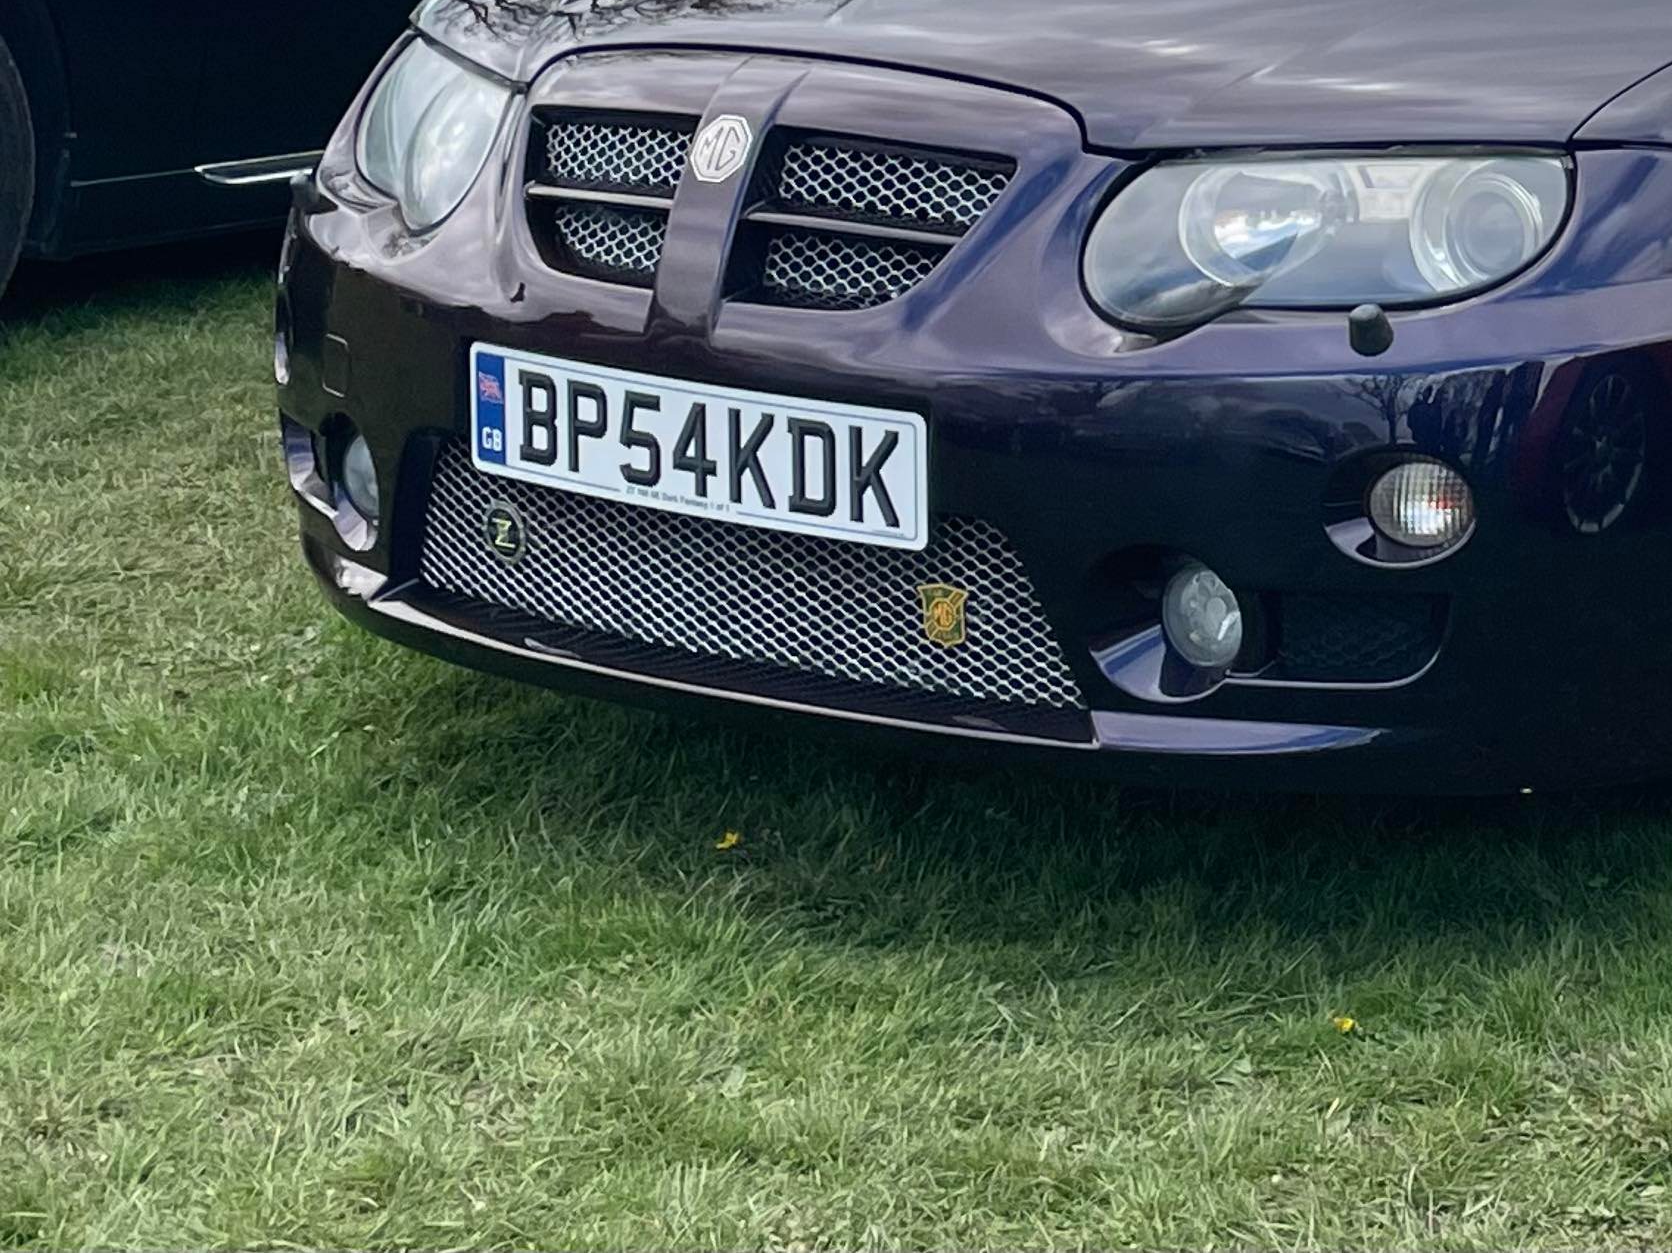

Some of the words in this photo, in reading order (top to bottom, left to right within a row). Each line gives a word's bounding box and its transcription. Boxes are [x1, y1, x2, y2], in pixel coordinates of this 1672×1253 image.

[697, 123, 744, 174] MG
[481, 426, 503, 452] GB
[519, 368, 901, 528] BP54KDK
